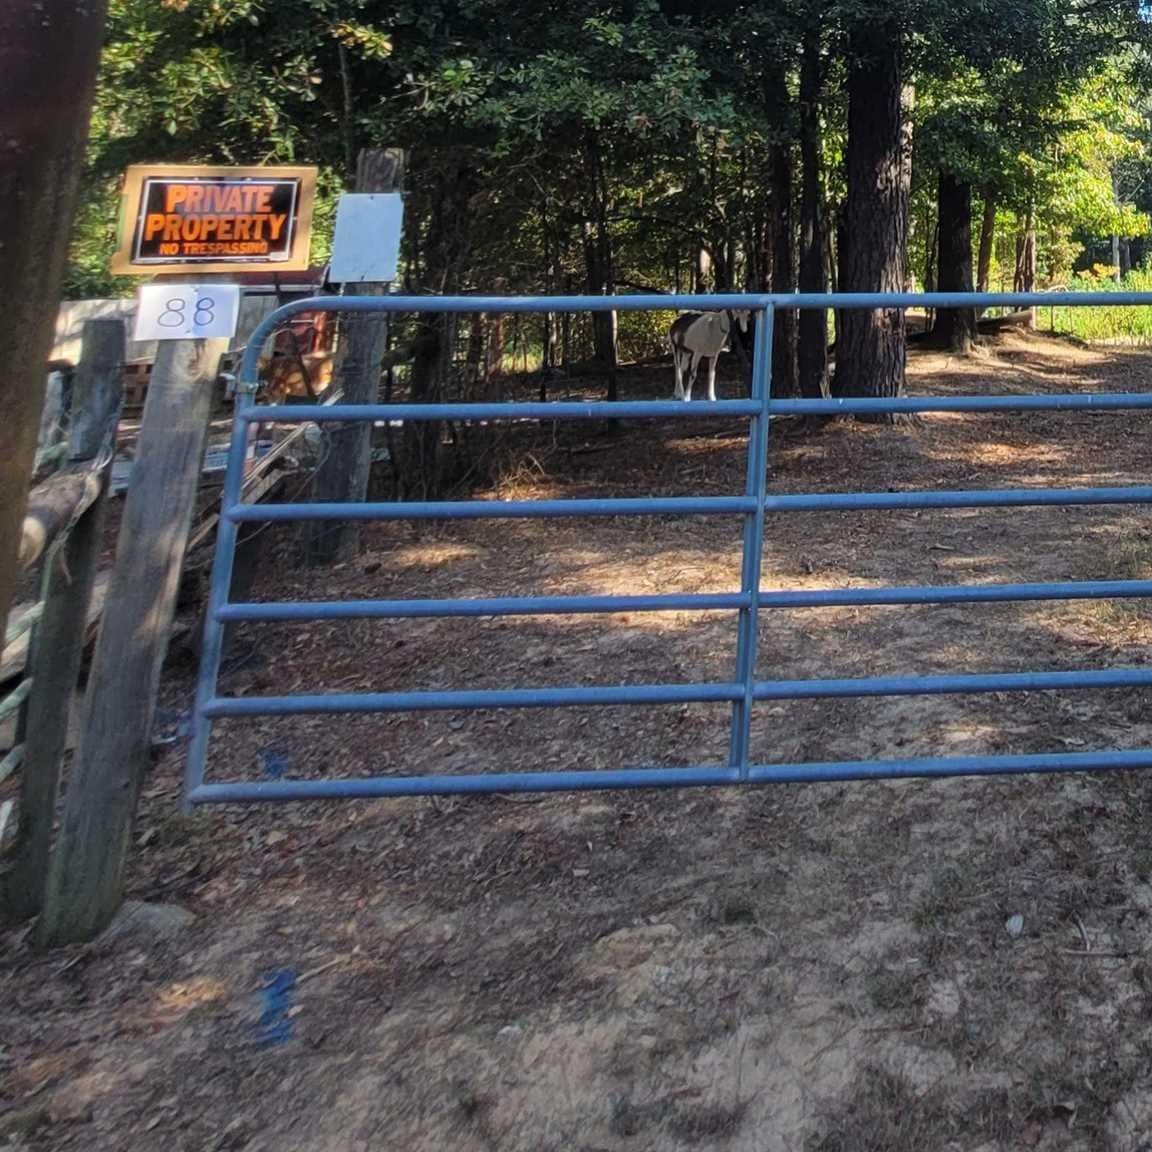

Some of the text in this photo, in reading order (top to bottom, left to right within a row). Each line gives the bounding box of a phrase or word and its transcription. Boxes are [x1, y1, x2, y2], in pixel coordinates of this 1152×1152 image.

[165, 184, 275, 213] PRIVATE
[144, 213, 286, 241] PROPERTY
[159, 241, 268, 255] NO TRESPASSING
[157, 298, 215, 328] 88
